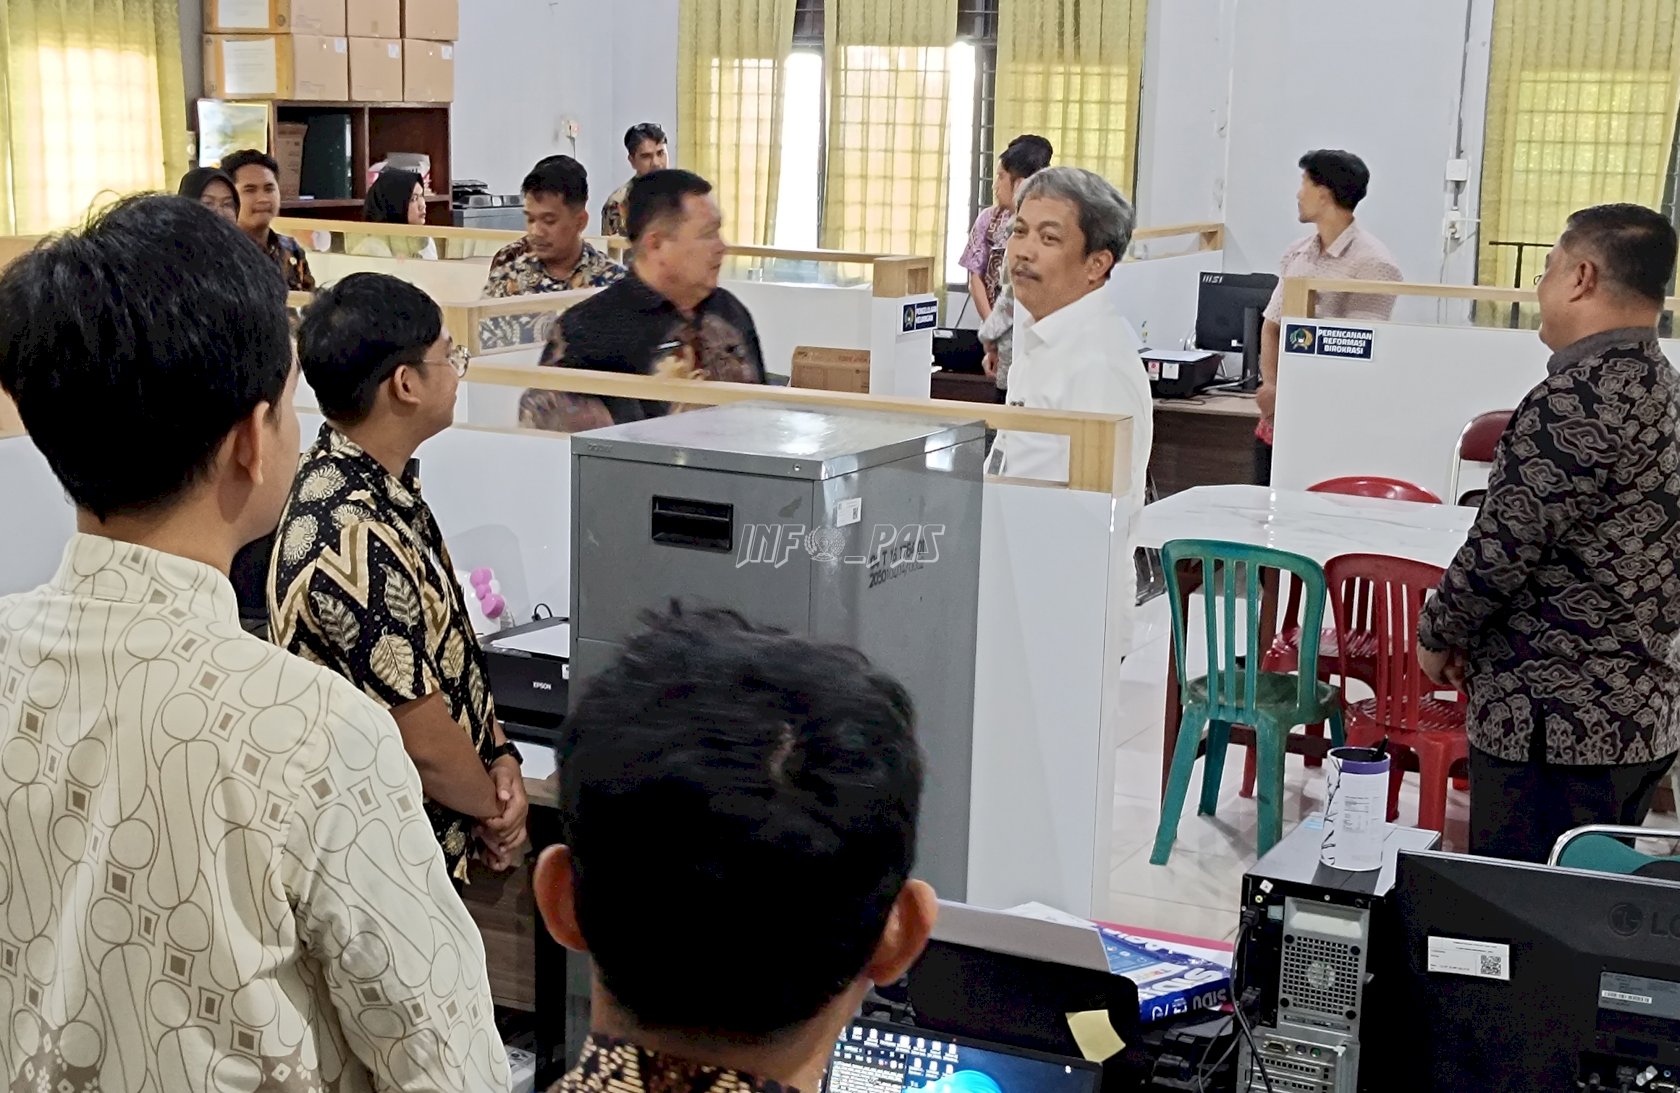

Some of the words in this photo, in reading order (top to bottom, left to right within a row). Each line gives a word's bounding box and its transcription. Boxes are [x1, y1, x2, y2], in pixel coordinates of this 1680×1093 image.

[1318, 329, 1372, 341] PERENCANAAN
[1323, 337, 1366, 347] REFORMASI
[1324, 345, 1364, 355] BIROKRASI
